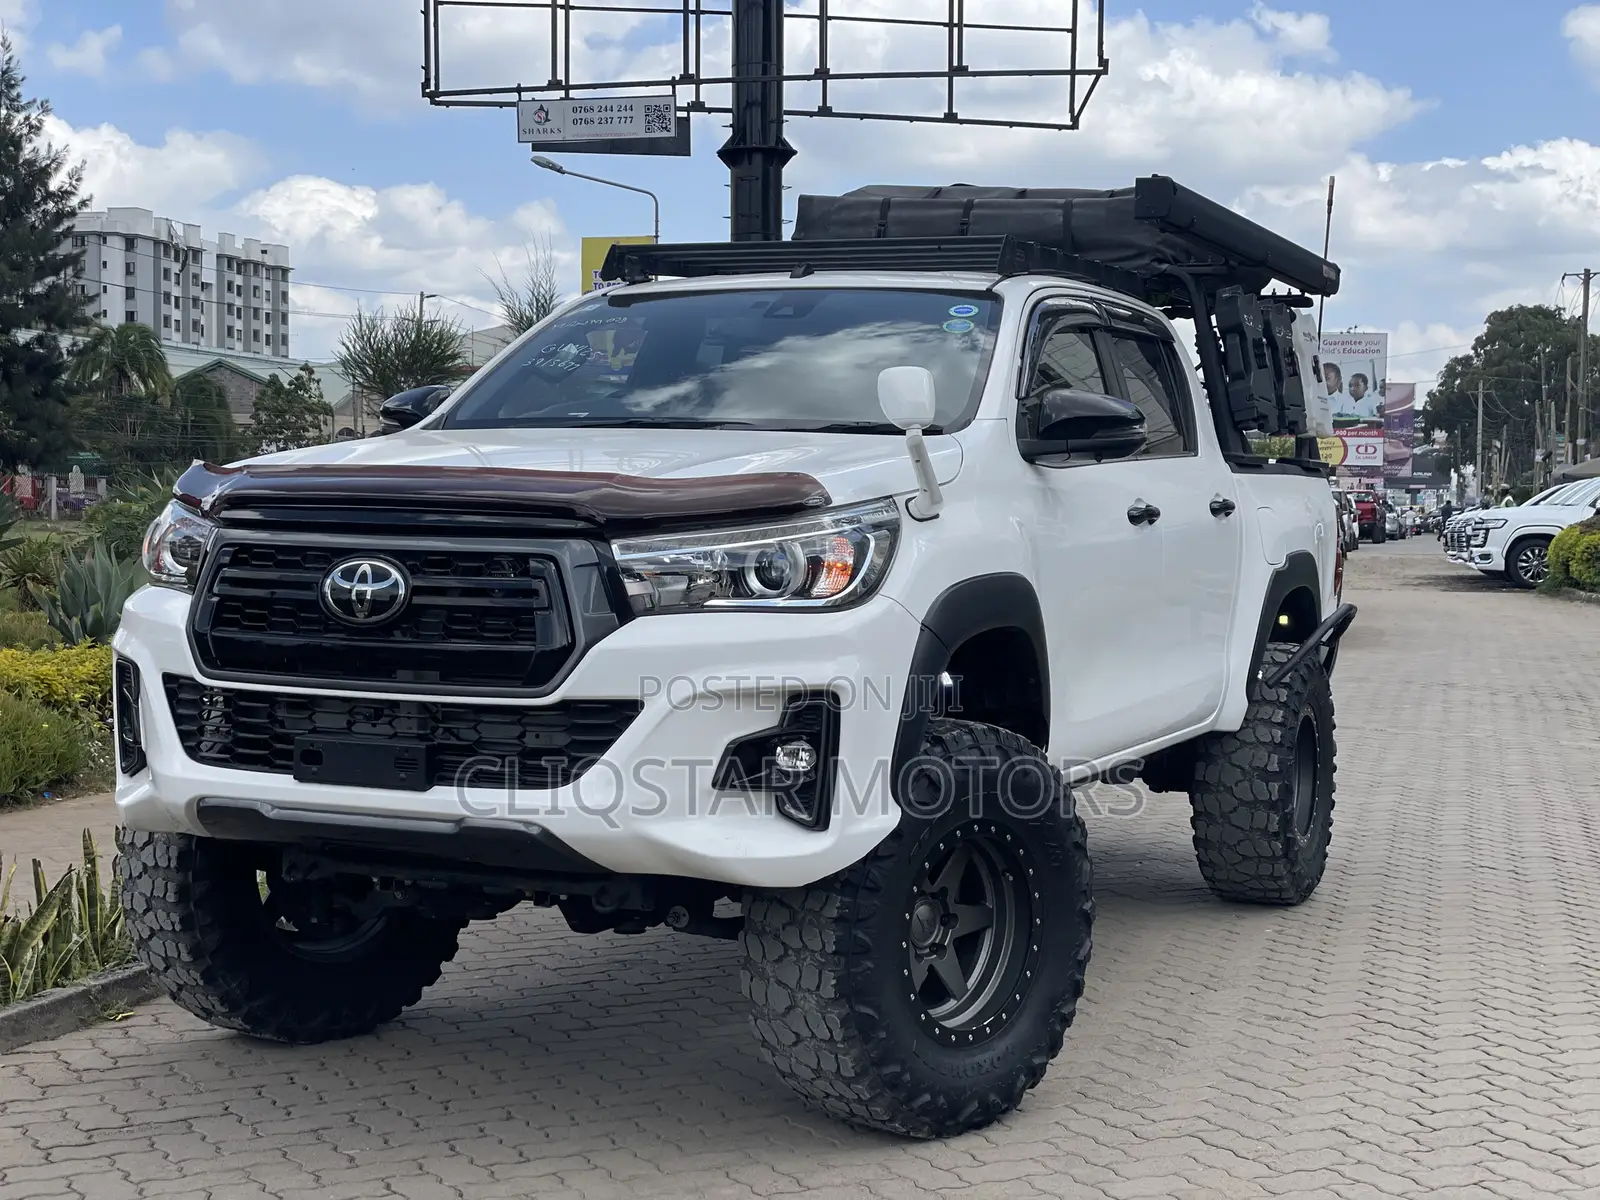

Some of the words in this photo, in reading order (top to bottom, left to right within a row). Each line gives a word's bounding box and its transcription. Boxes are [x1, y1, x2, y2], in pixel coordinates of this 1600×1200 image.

[572, 105, 595, 114] 0768
[597, 104, 614, 113] 244
[616, 103, 634, 112] 244
[572, 117, 595, 126] 0768
[597, 116, 614, 125] 237
[617, 115, 634, 124] 777
[522, 127, 562, 135] SHARKS
[1342, 346, 1381, 354] Education
